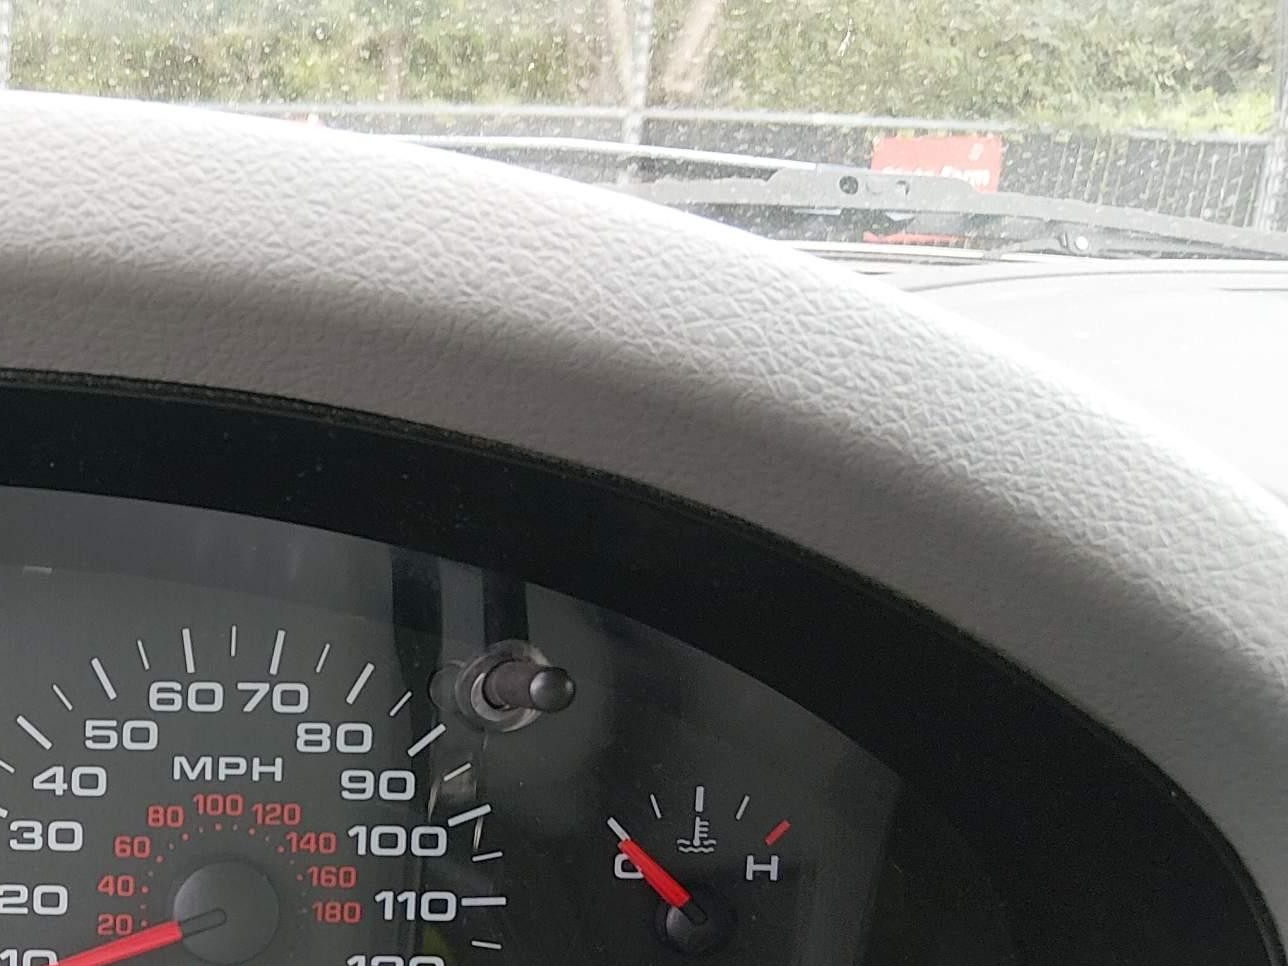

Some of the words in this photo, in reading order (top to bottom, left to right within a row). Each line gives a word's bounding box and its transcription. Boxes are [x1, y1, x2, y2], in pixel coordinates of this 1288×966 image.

[150, 682, 223, 711] 60
[238, 683, 308, 712] 70
[86, 720, 157, 749] 50
[297, 723, 372, 752] 80
[174, 757, 282, 781] MPH
[34, 767, 106, 796] 40
[342, 770, 414, 800] 90
[148, 807, 184, 826] 80
[195, 795, 244, 816] 100
[254, 804, 301, 825] 120
[10, 821, 82, 851] 30
[115, 836, 150, 858] 60
[288, 832, 336, 853] 140
[348, 826, 446, 856] 100
[311, 867, 357, 887] 160
[746, 856, 778, 880] H
[98, 876, 134, 896] 40
[316, 902, 361, 923] 180
[375, 891, 456, 921] 110
[98, 914, 134, 934] 20
